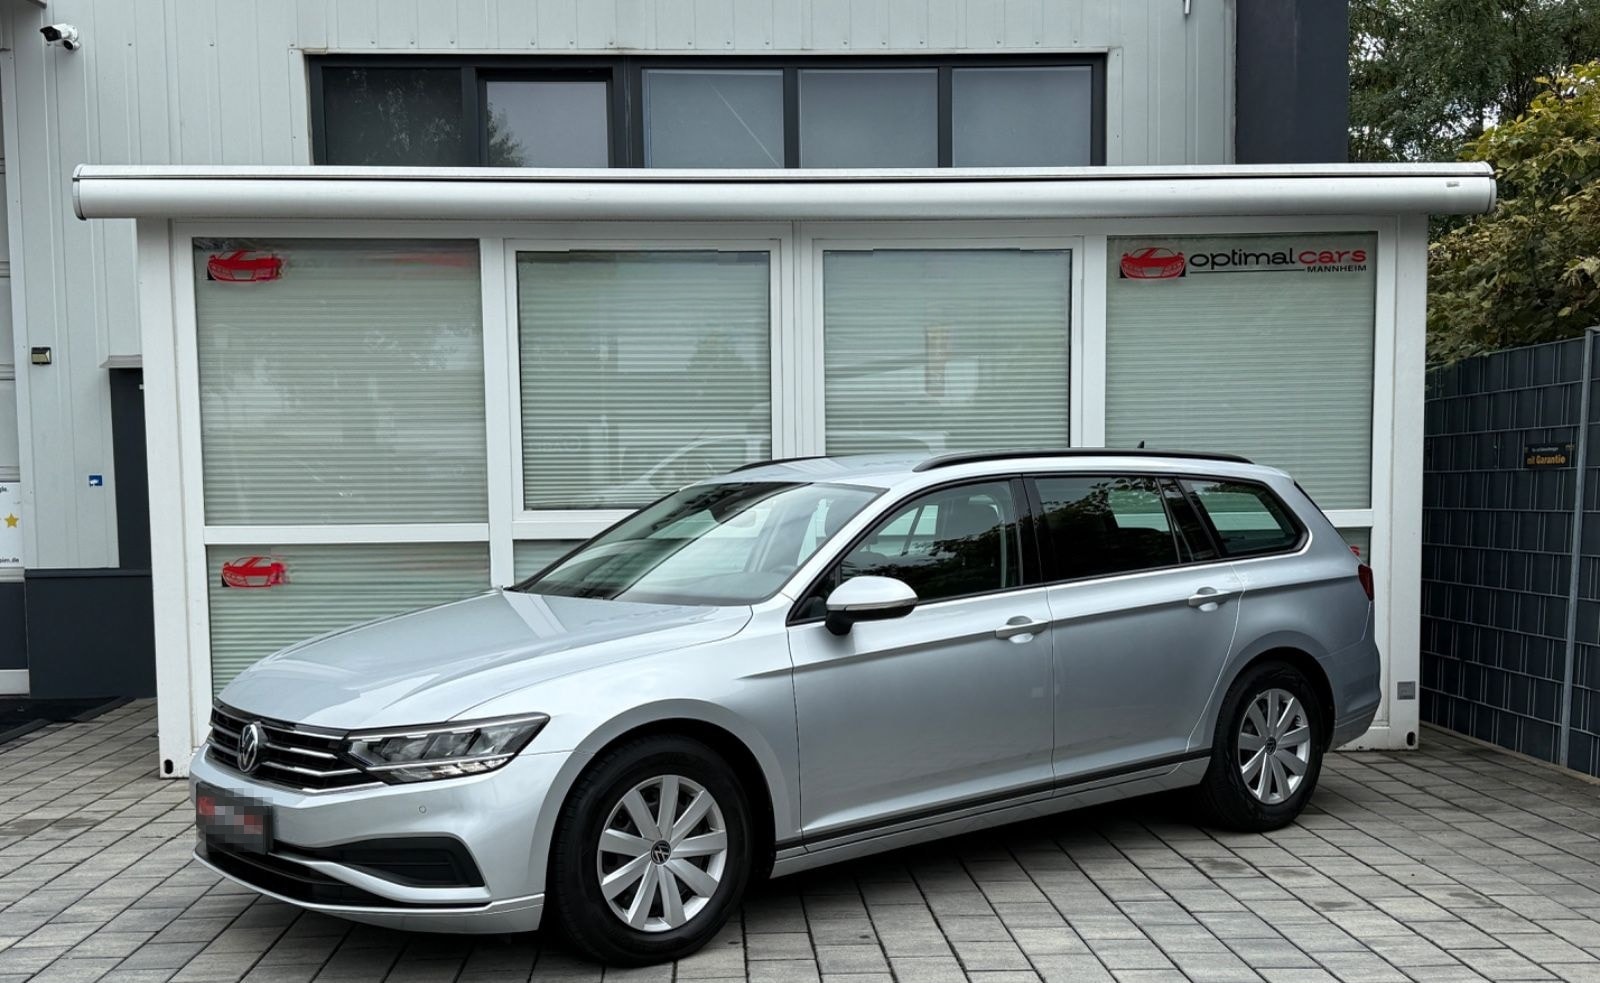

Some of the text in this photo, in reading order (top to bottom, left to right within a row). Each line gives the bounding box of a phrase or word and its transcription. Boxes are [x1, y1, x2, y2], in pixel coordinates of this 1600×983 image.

[1189, 248, 1367, 270] optimal cars
[1306, 264, 1367, 273] MANNHEIM
